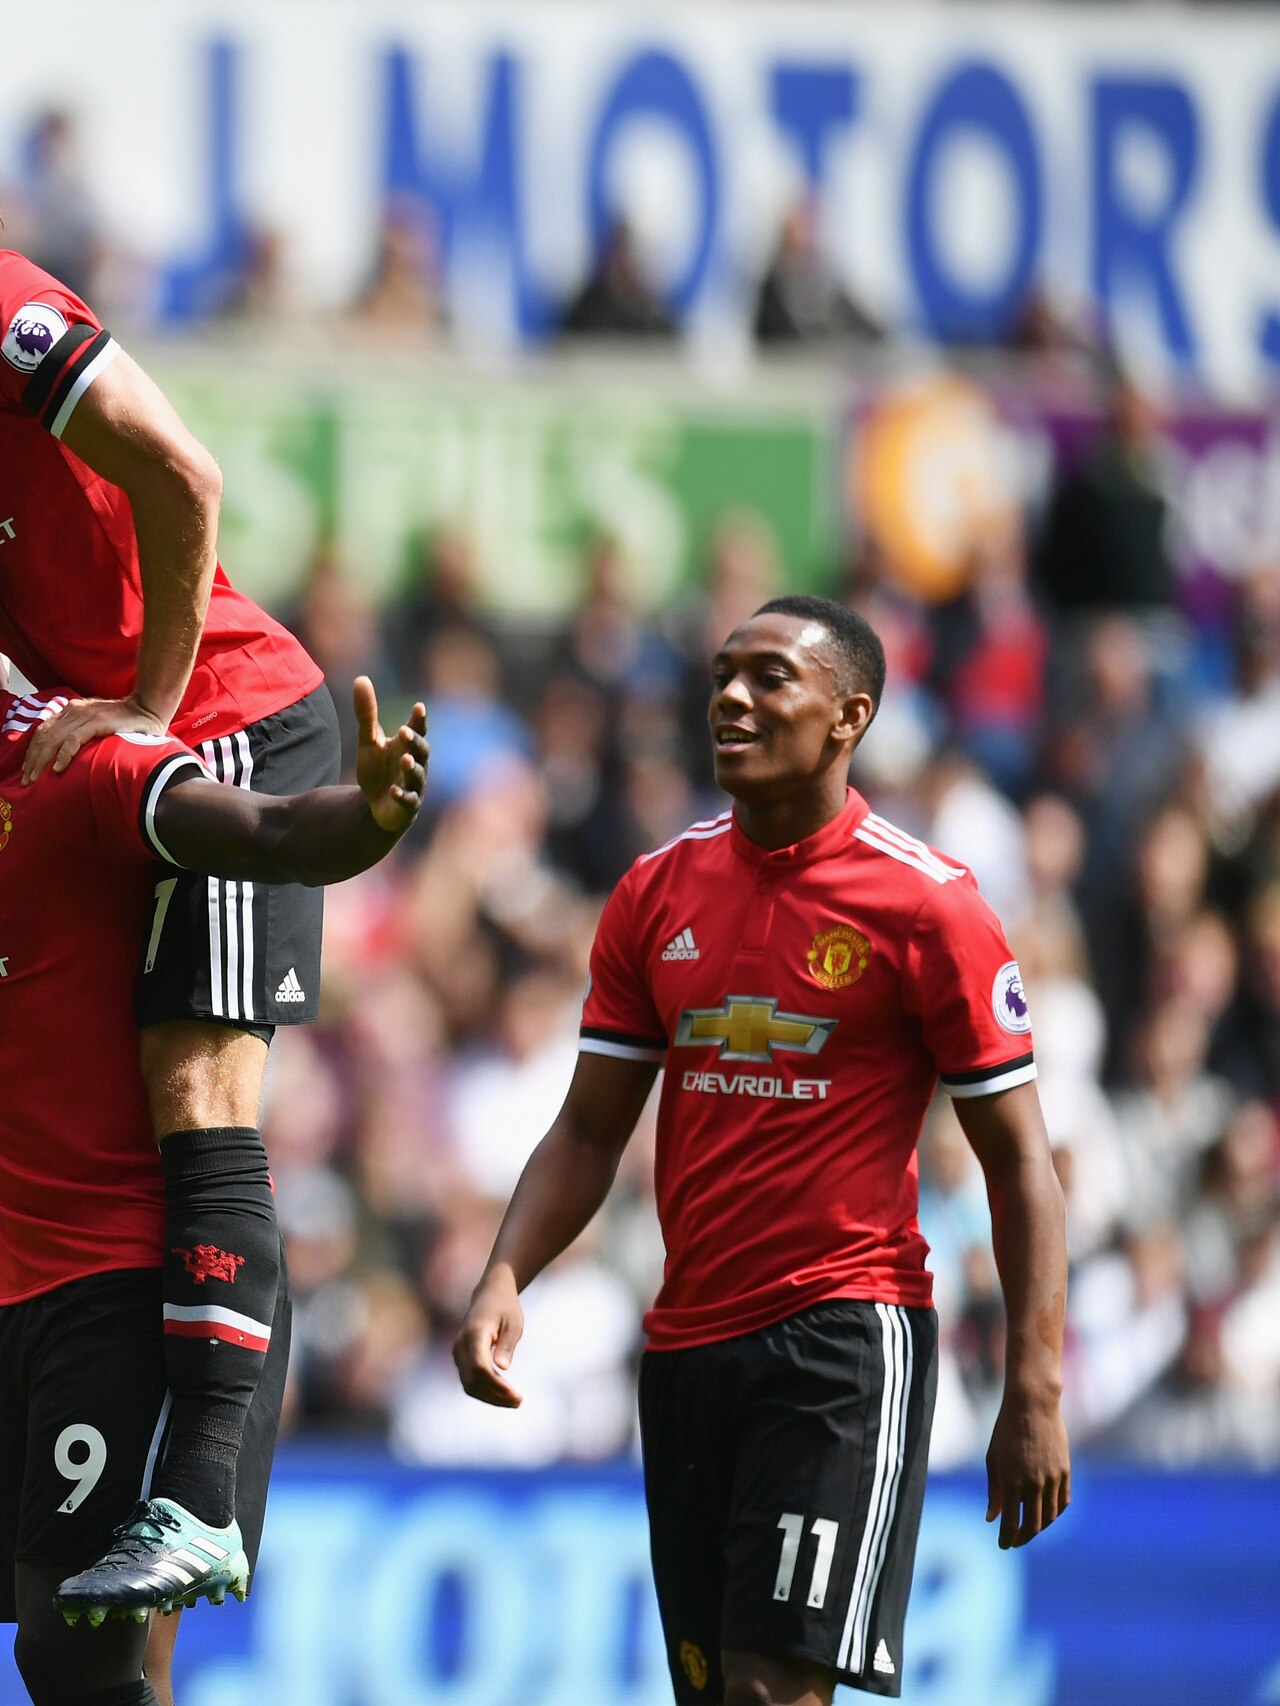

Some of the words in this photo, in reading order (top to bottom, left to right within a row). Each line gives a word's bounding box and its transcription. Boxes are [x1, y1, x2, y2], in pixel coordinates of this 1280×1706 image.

[380, 38, 1280, 370] MOTOR
[191, 711, 218, 729] adizero
[661, 948, 700, 961] adidas
[275, 990, 305, 1003] adidas
[682, 1071, 832, 1100] CHEVROLET
[54, 1423, 107, 1514] 9
[772, 1512, 839, 1609] 11
